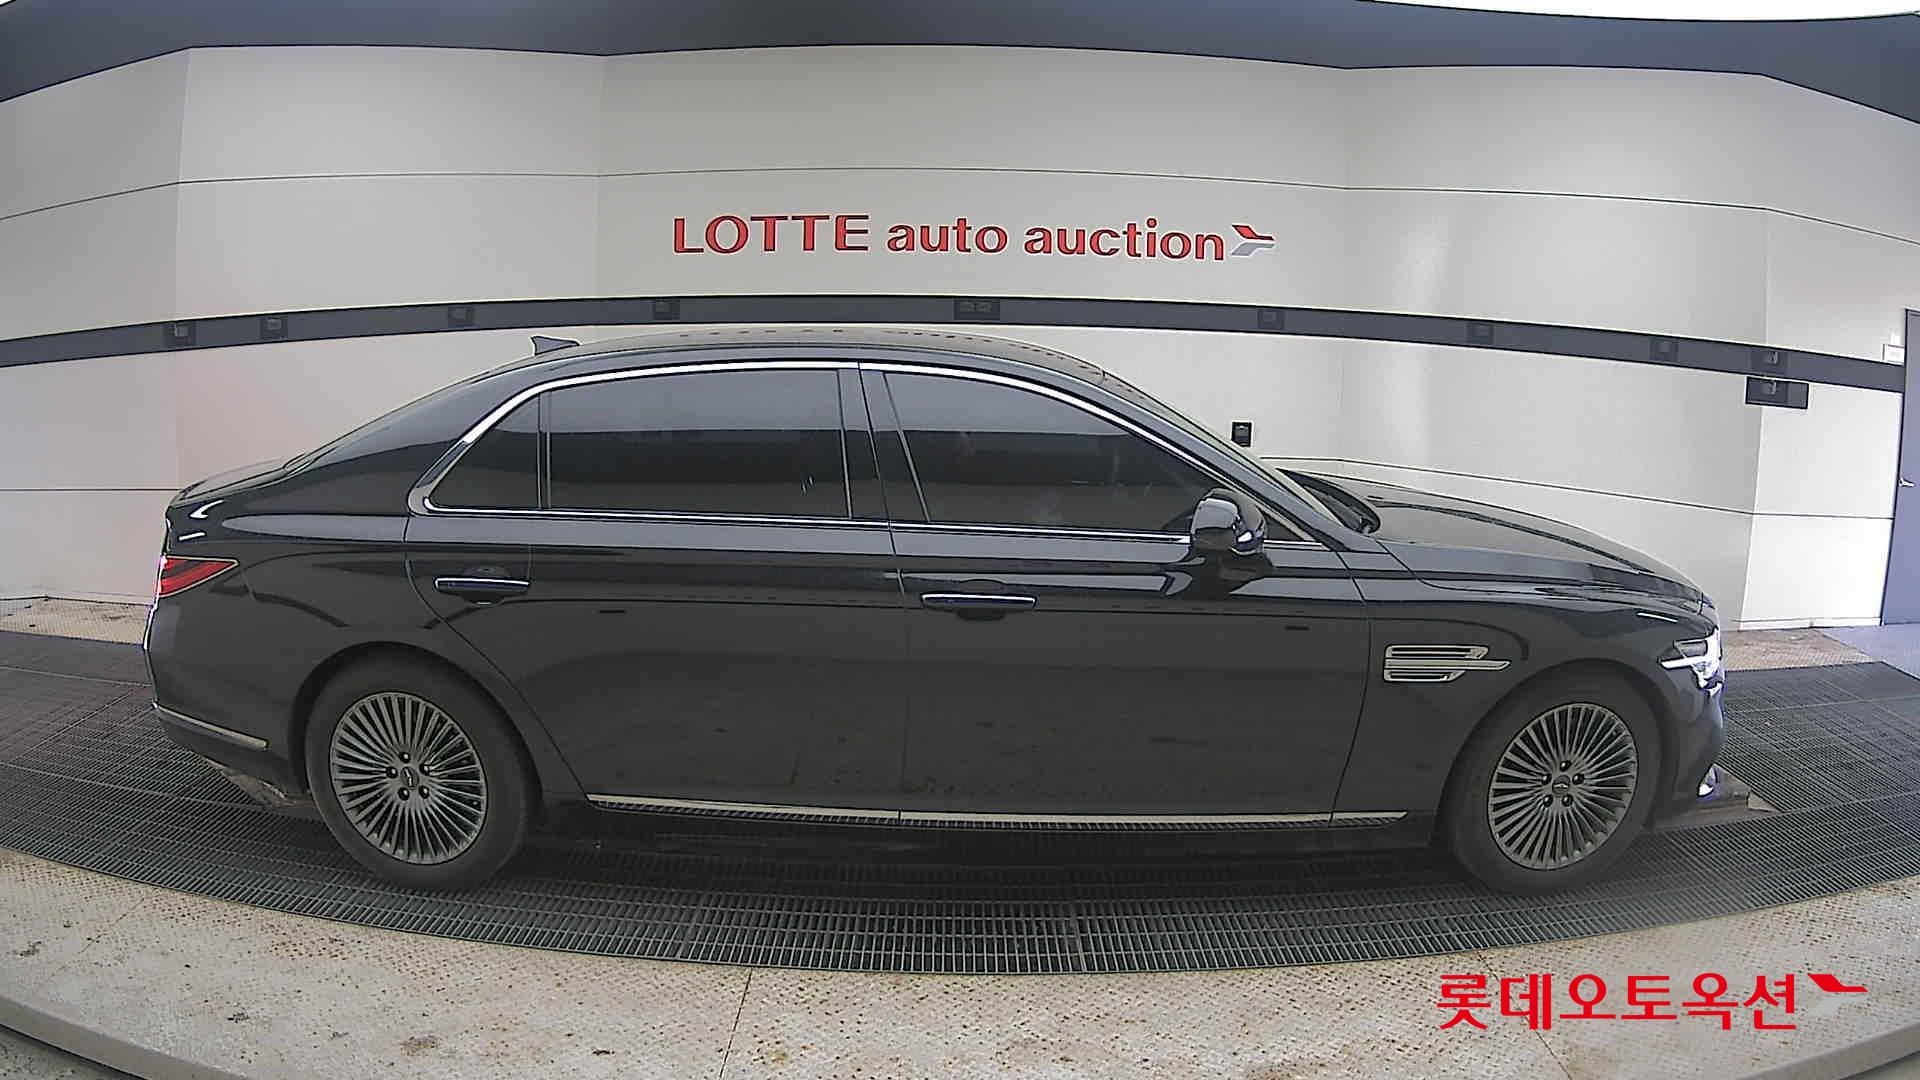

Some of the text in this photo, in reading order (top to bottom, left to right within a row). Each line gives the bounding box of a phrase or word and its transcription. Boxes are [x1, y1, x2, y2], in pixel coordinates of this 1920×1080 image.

[673, 215, 1225, 261] LOTTE auto auction
